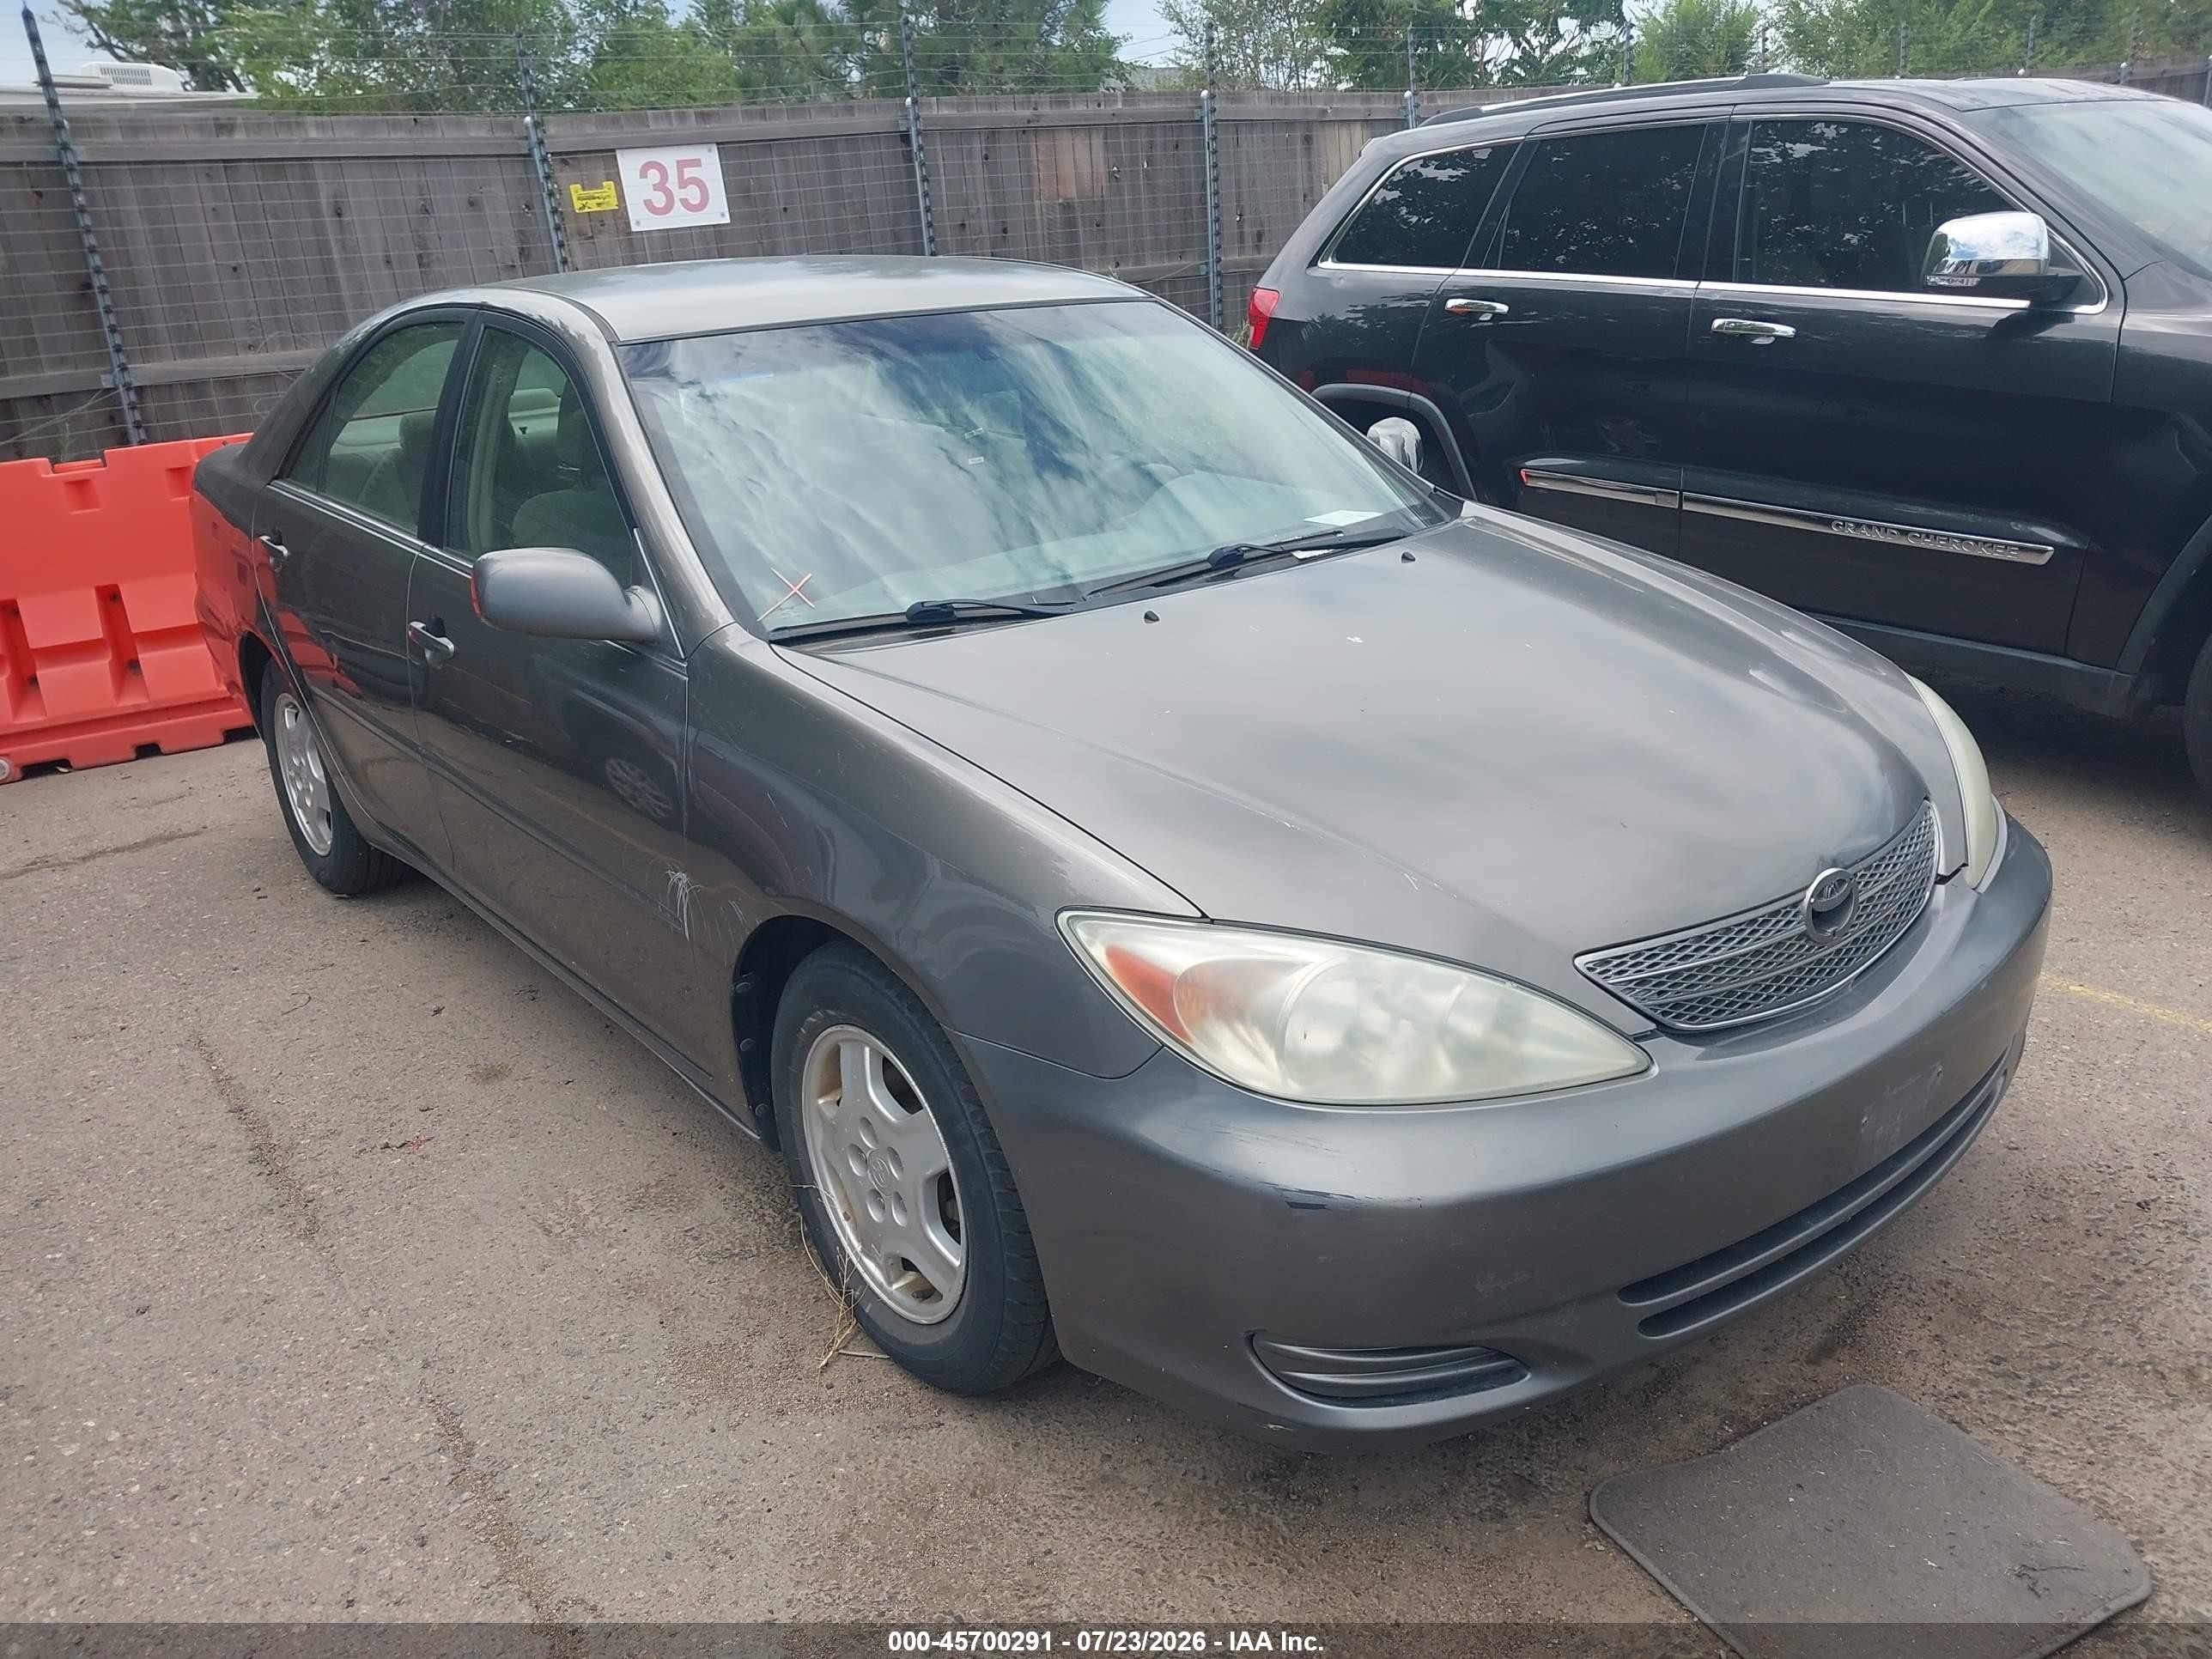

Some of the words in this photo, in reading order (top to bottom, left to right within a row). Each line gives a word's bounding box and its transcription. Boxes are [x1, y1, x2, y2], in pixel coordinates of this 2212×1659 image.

[639, 158, 709, 216] 35
[1831, 520, 1900, 541] GRAND
[1906, 531, 2020, 559] CHEROKEE
